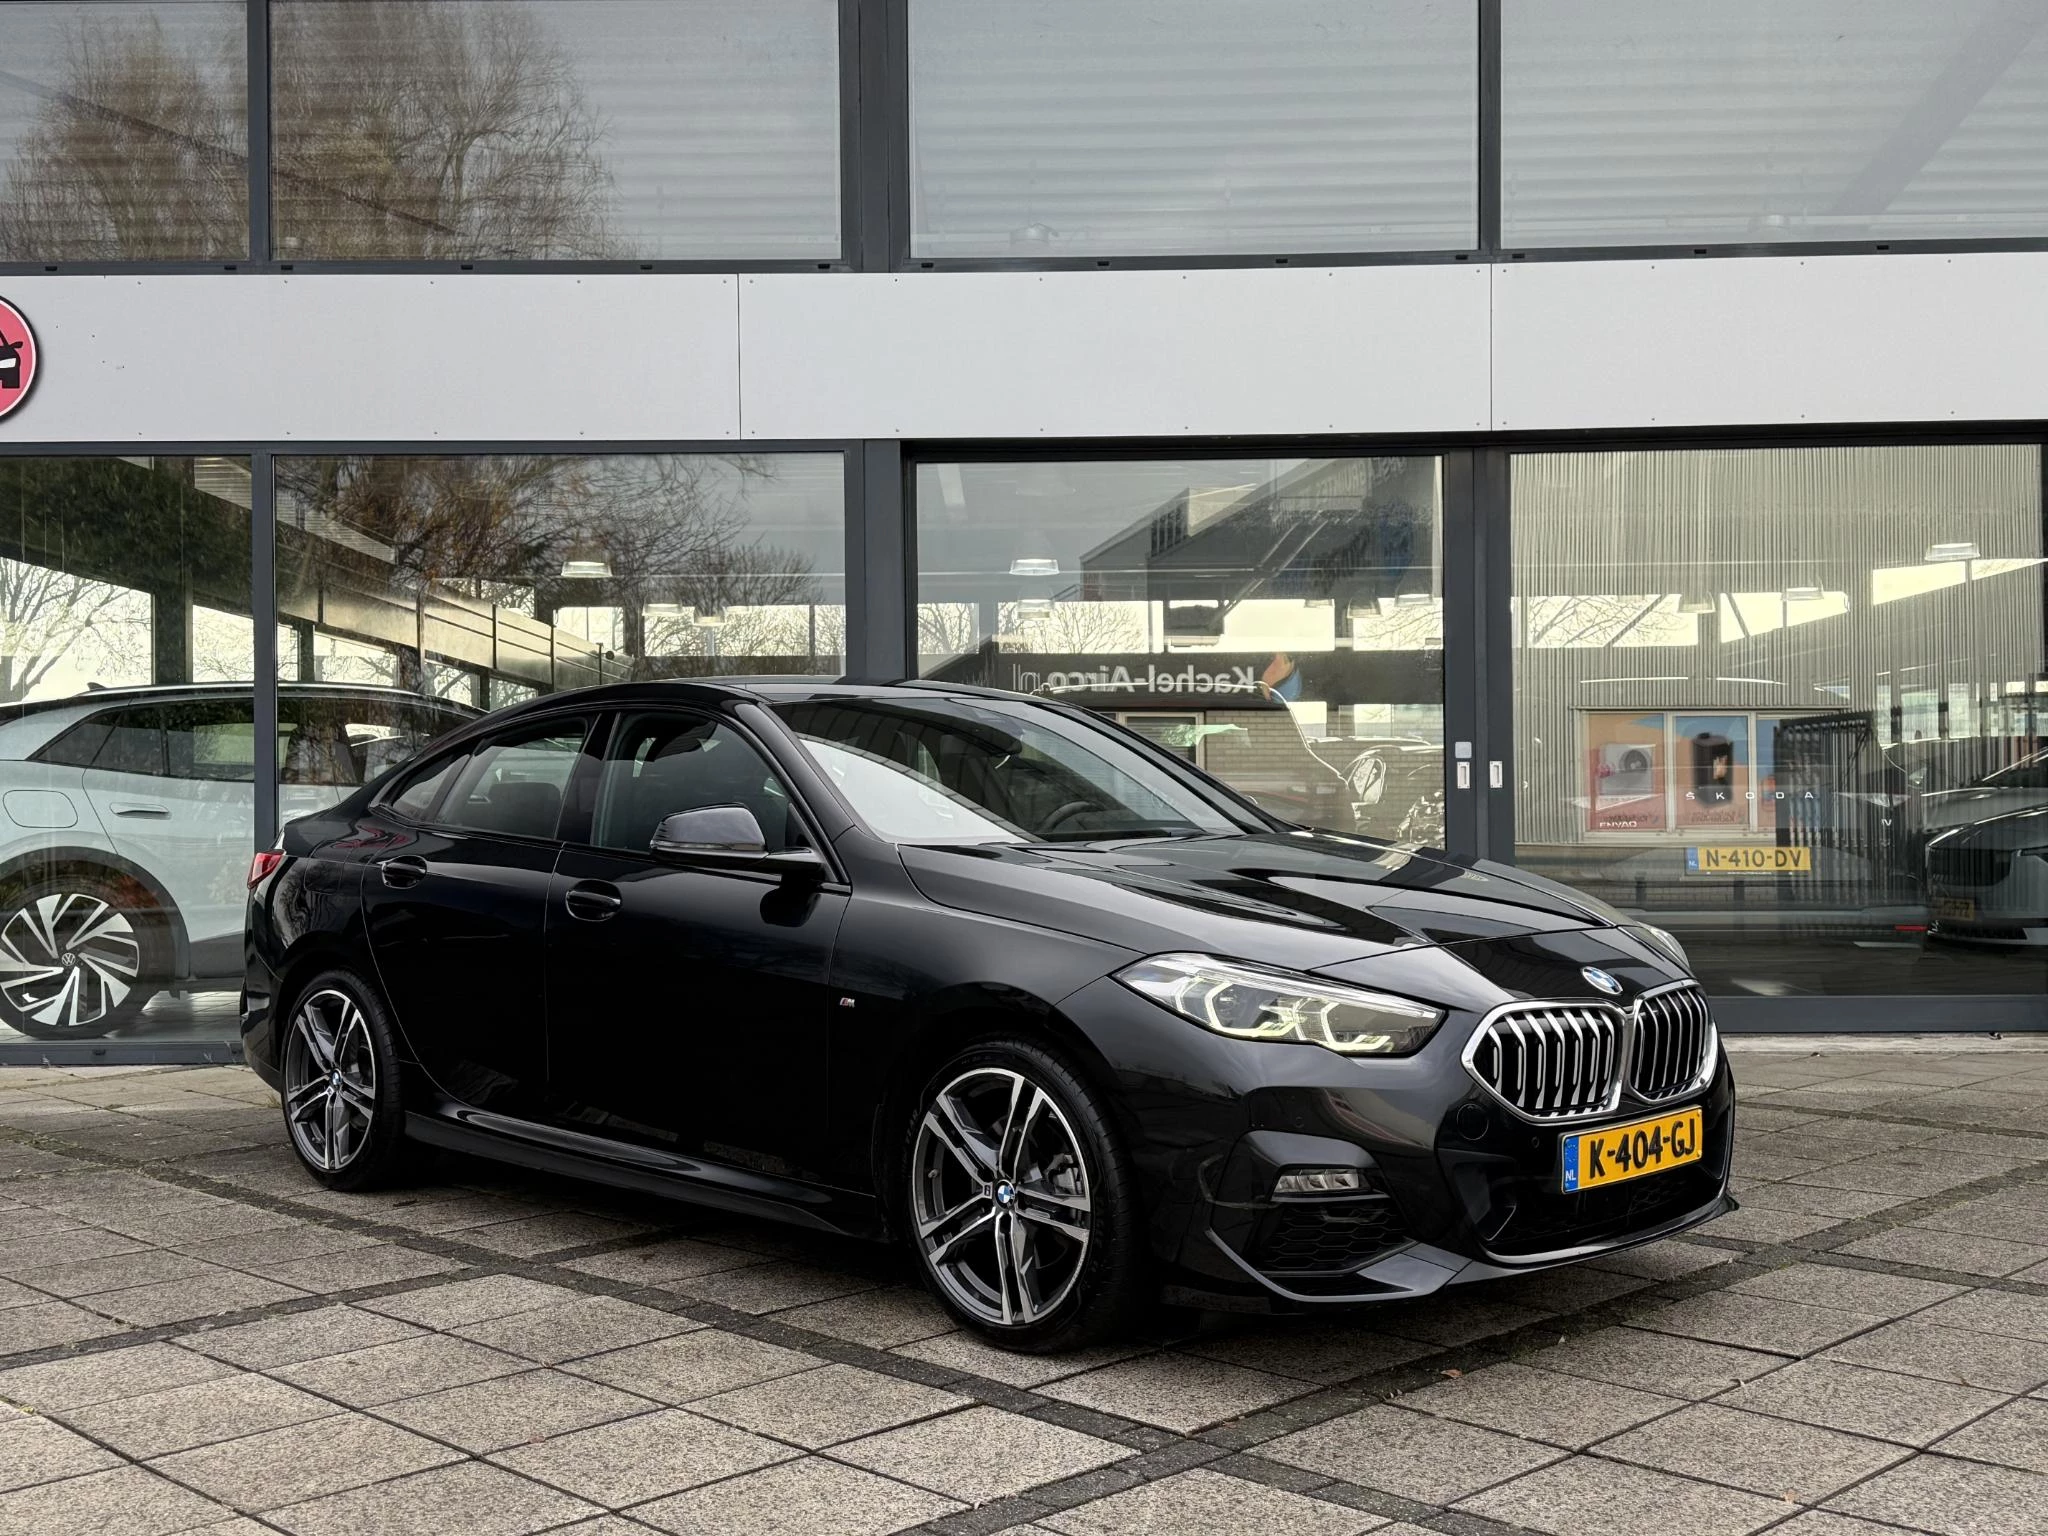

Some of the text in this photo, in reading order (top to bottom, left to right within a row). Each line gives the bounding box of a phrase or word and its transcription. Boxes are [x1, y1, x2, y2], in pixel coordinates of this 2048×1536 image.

[1706, 849, 1802, 868] N-410-DV
[1565, 1118, 1696, 1182] NL K-404-GJ
